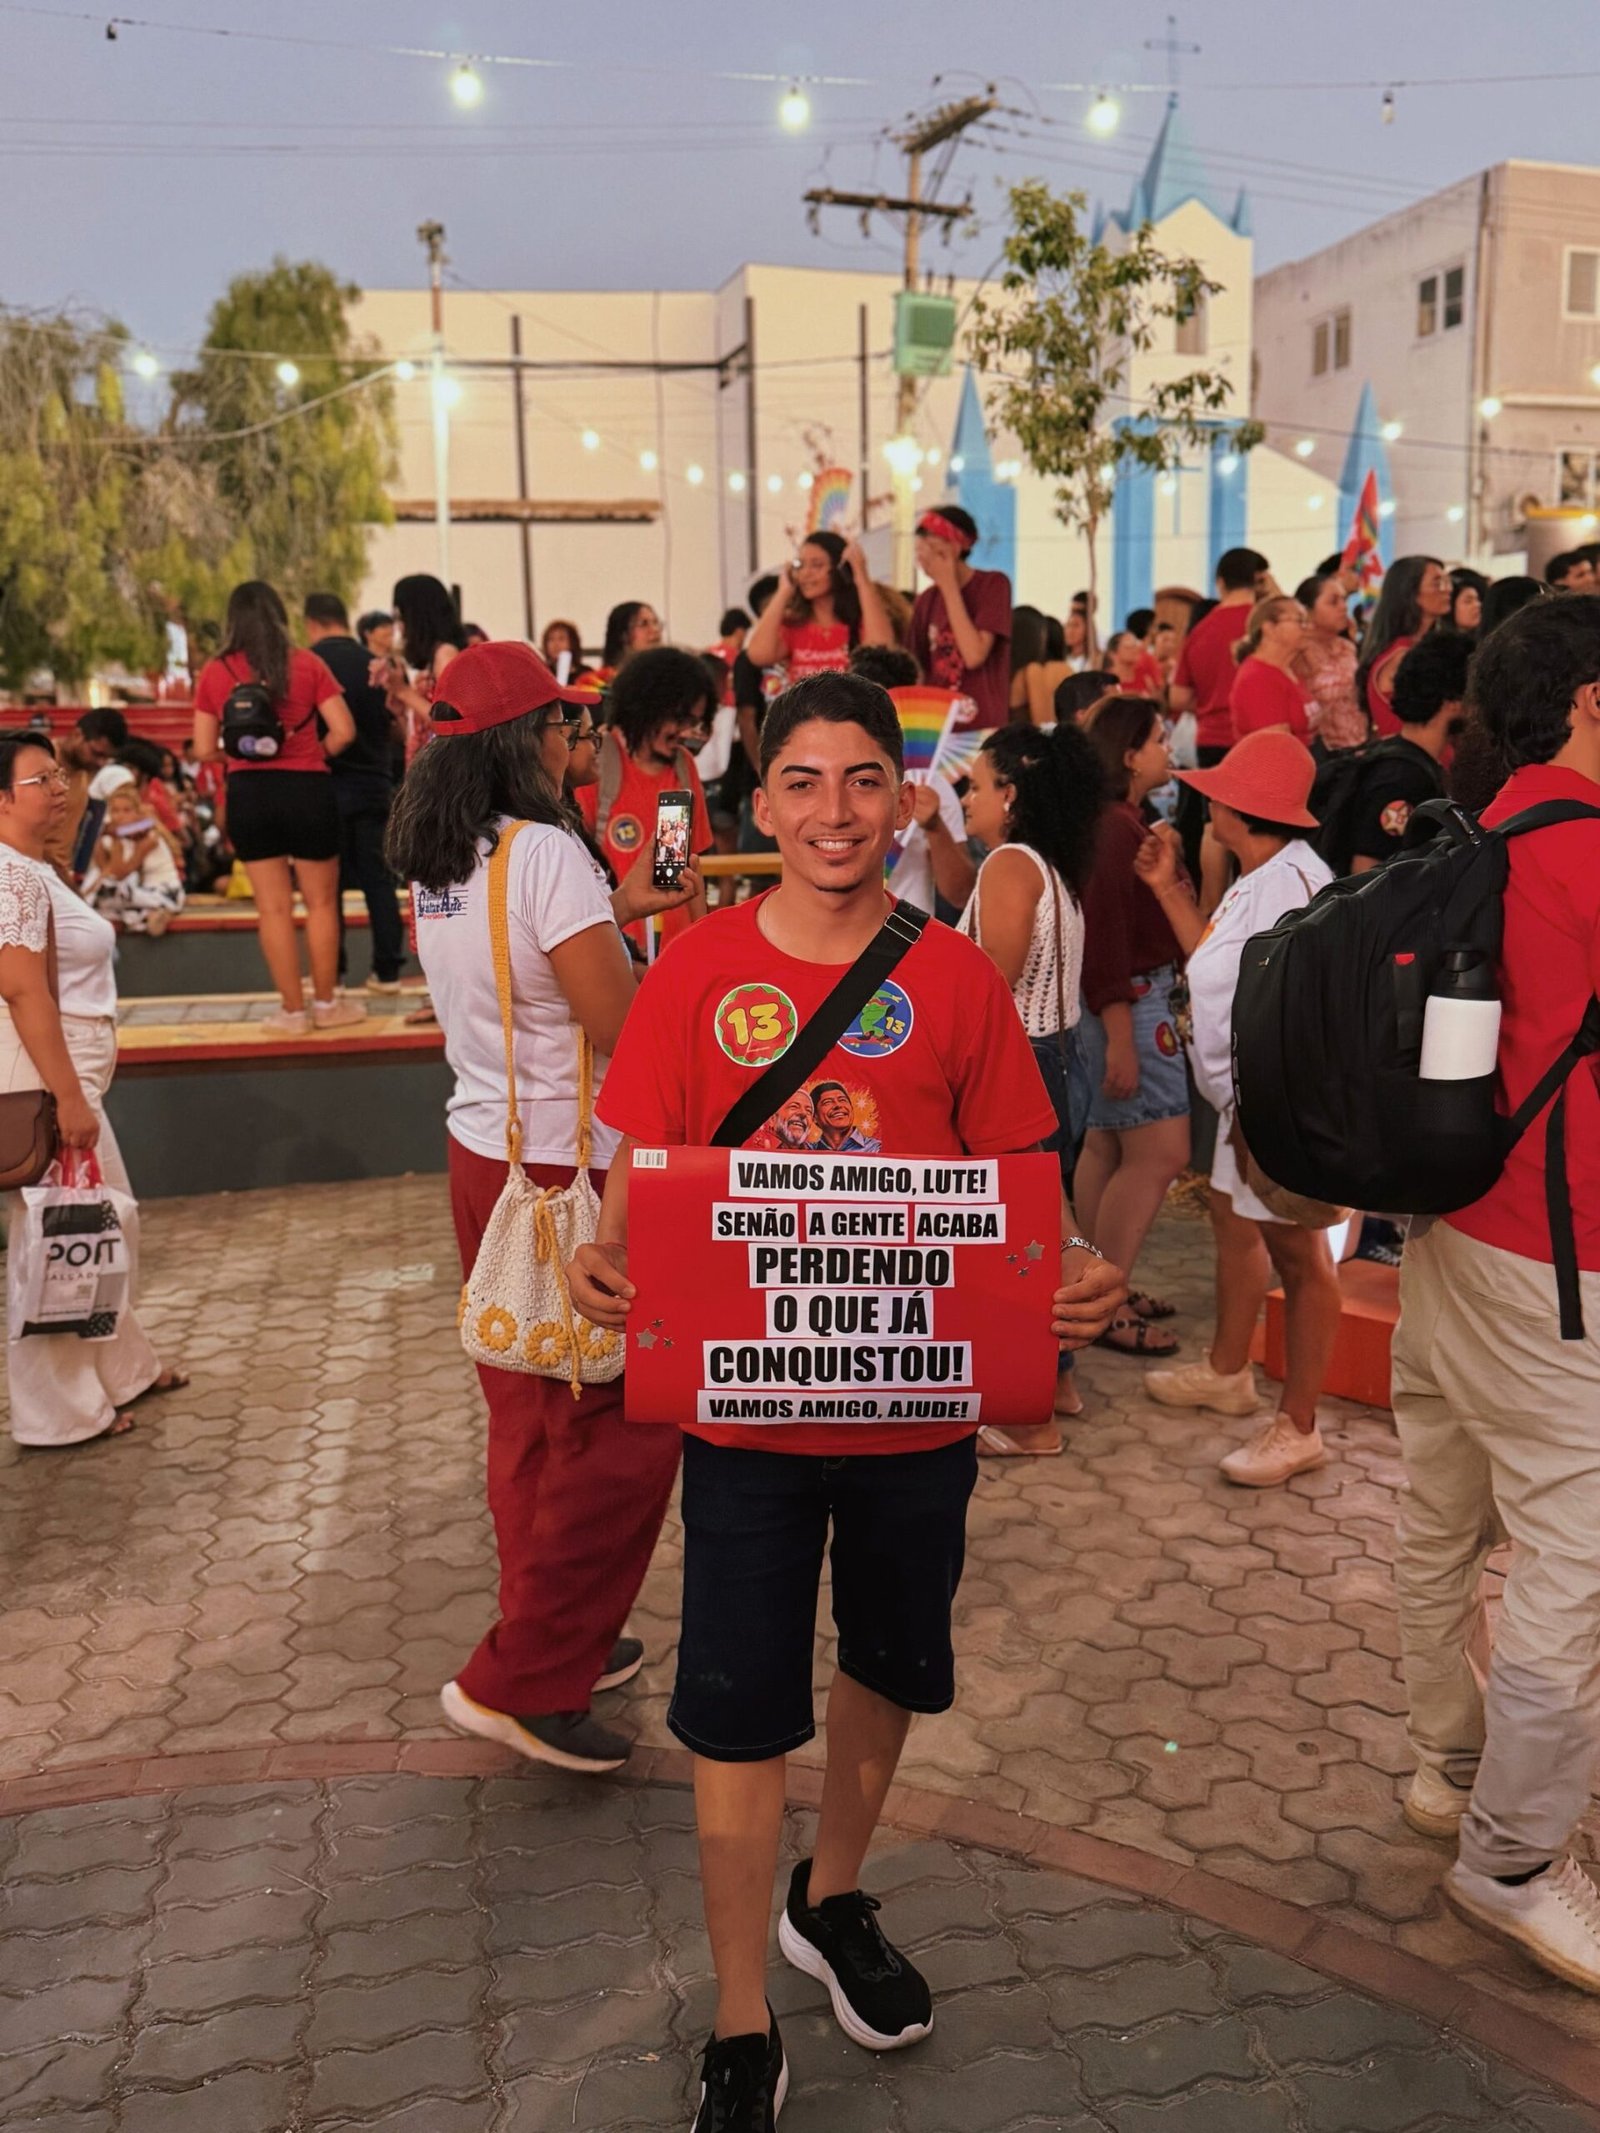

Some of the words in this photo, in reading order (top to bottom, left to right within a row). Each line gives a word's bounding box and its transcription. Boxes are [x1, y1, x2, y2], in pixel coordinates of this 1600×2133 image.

[727, 1002, 783, 1046] 13
[885, 1016, 906, 1034] 13
[737, 1162, 825, 1190] VAMOS
[829, 1165, 917, 1195] AMIGO,
[923, 1168, 987, 1194] LUTE!
[717, 1208, 795, 1238] SENÃO
[809, 1212, 826, 1236] A
[831, 1212, 905, 1237] GENTE
[916, 1212, 998, 1238] ACABA
[756, 1248, 950, 1286] PERDENDO
[773, 1294, 798, 1333] O
[808, 1295, 879, 1337] QUE
[887, 1291, 928, 1335] JÁ
[709, 1345, 964, 1387] CONQUISTOU!
[708, 1399, 794, 1419] VAMOS
[798, 1400, 883, 1420] AMIGO,
[886, 1400, 969, 1419] AJUDE!
